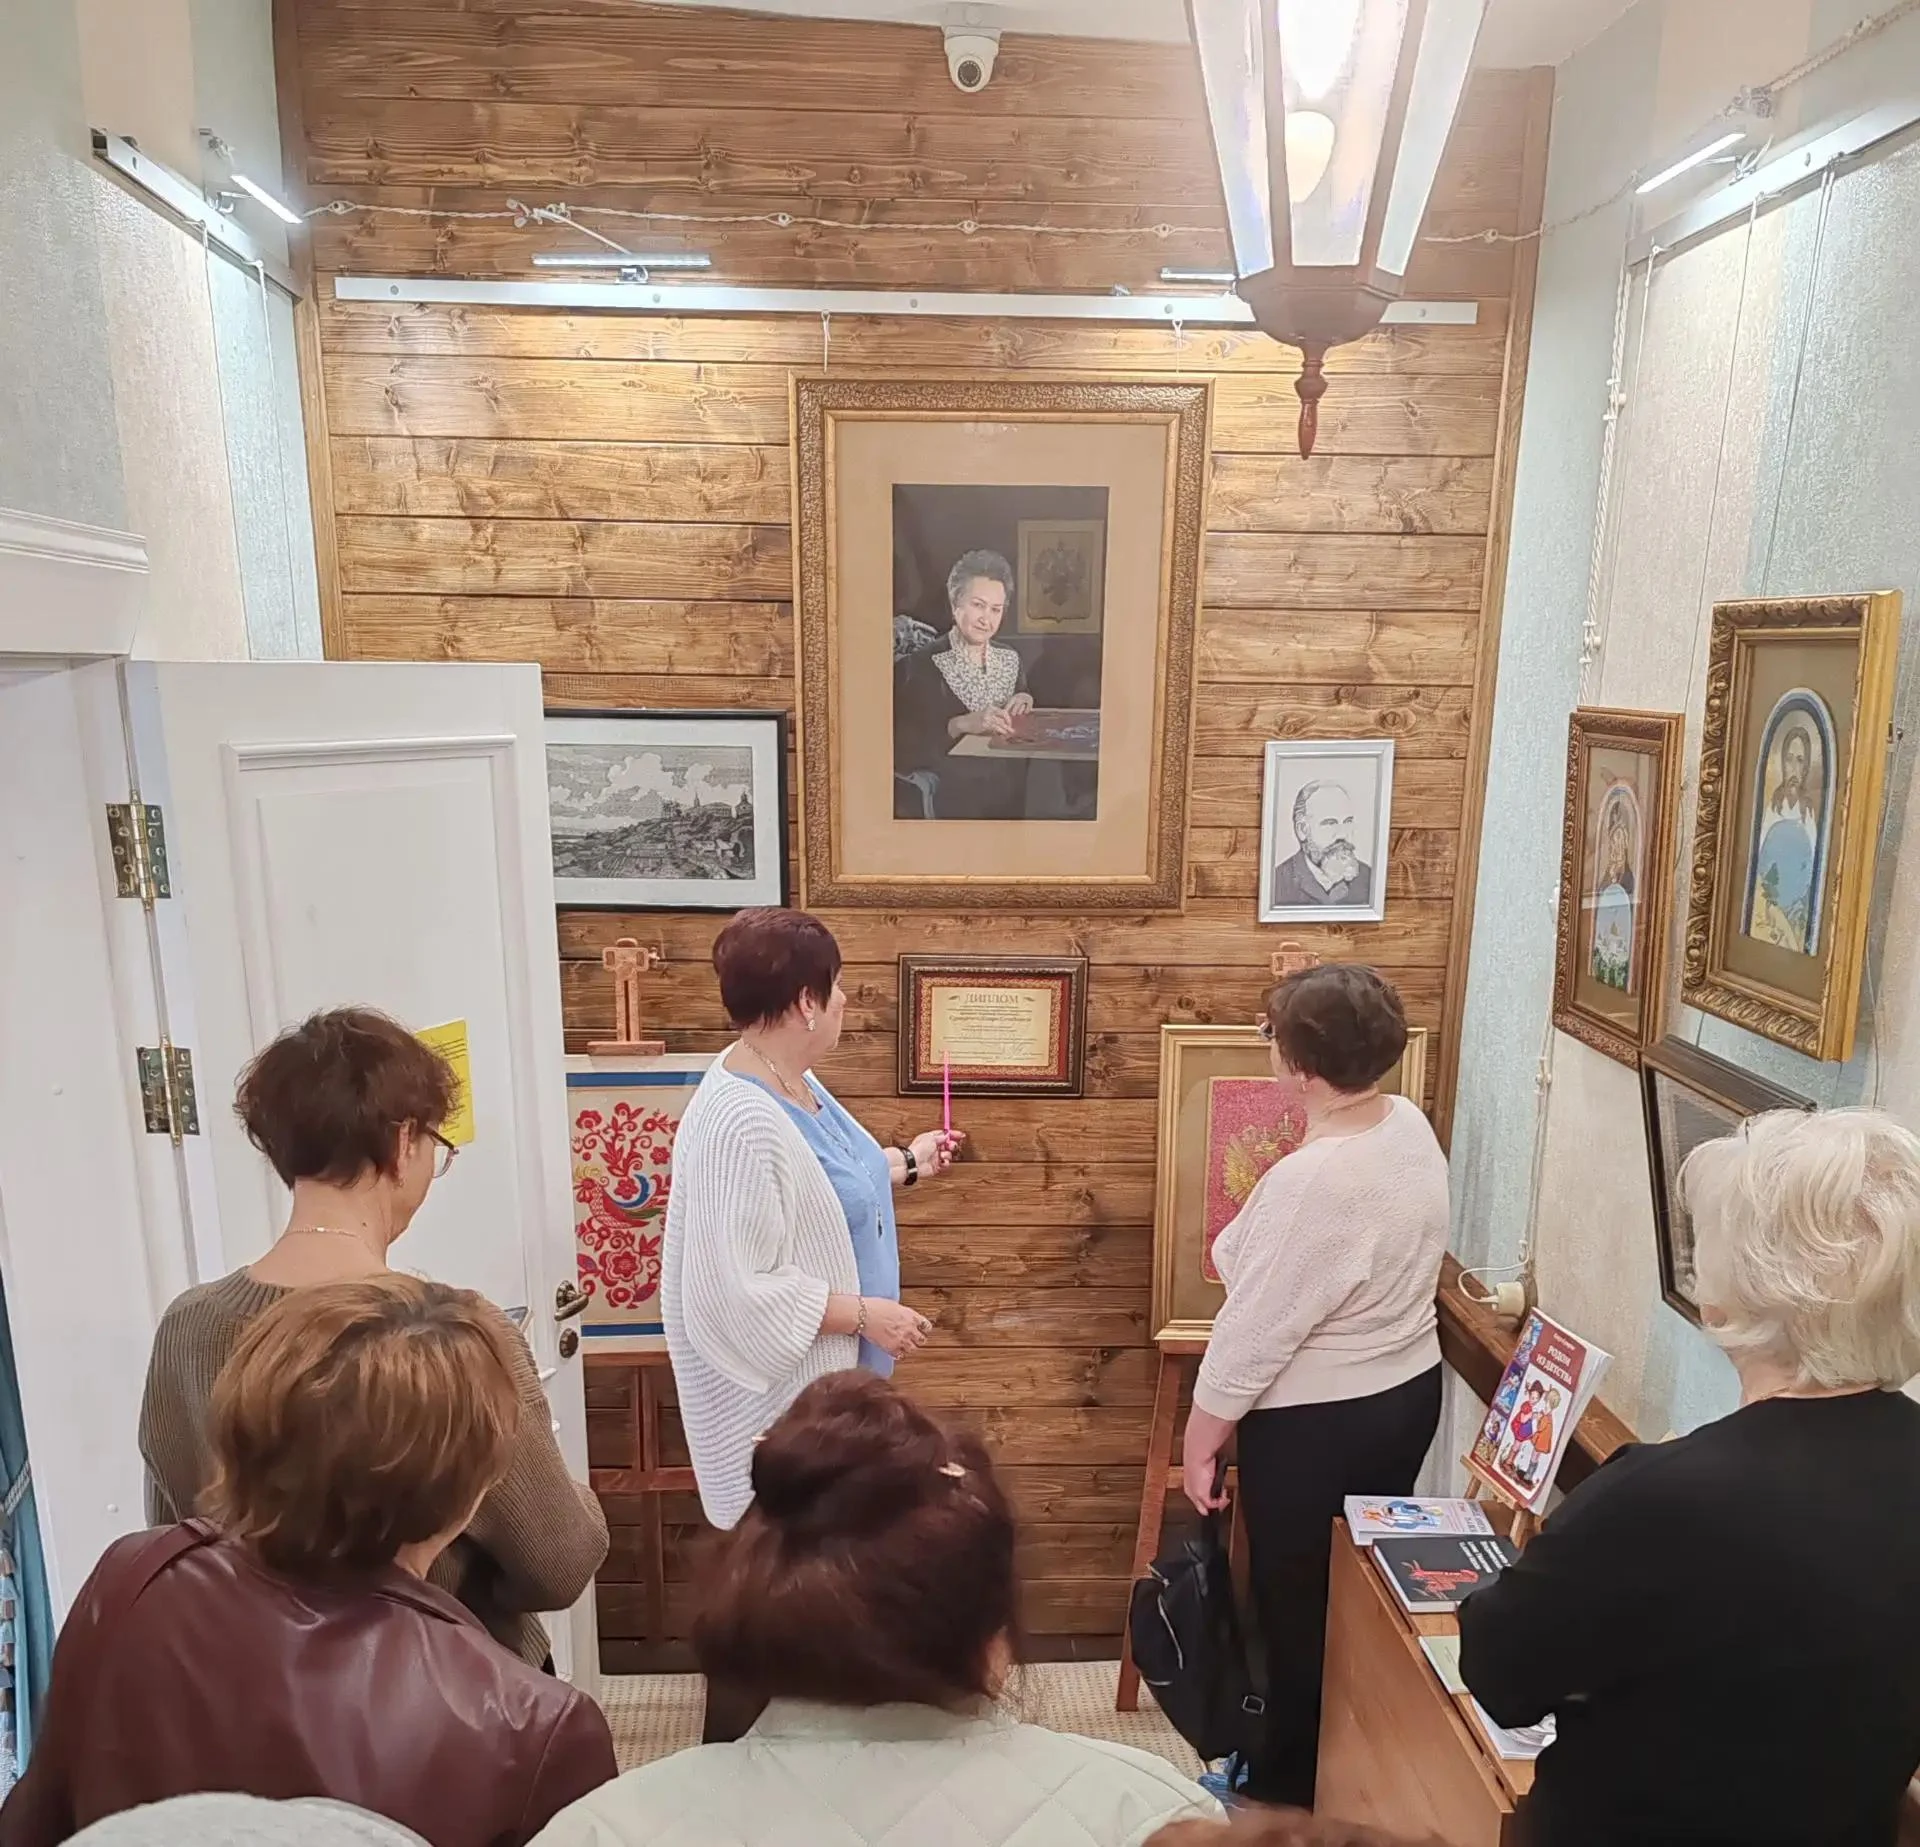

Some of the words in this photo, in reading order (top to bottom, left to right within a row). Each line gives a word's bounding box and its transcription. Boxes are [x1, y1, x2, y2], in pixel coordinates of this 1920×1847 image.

[964, 992, 1018, 1004] ДИПЛОМ
[1547, 1344, 1571, 1367] РОДОМ
[1536, 1353, 1547, 1366] ИЗ
[1542, 1360, 1572, 1385] ДЕТСТВА
